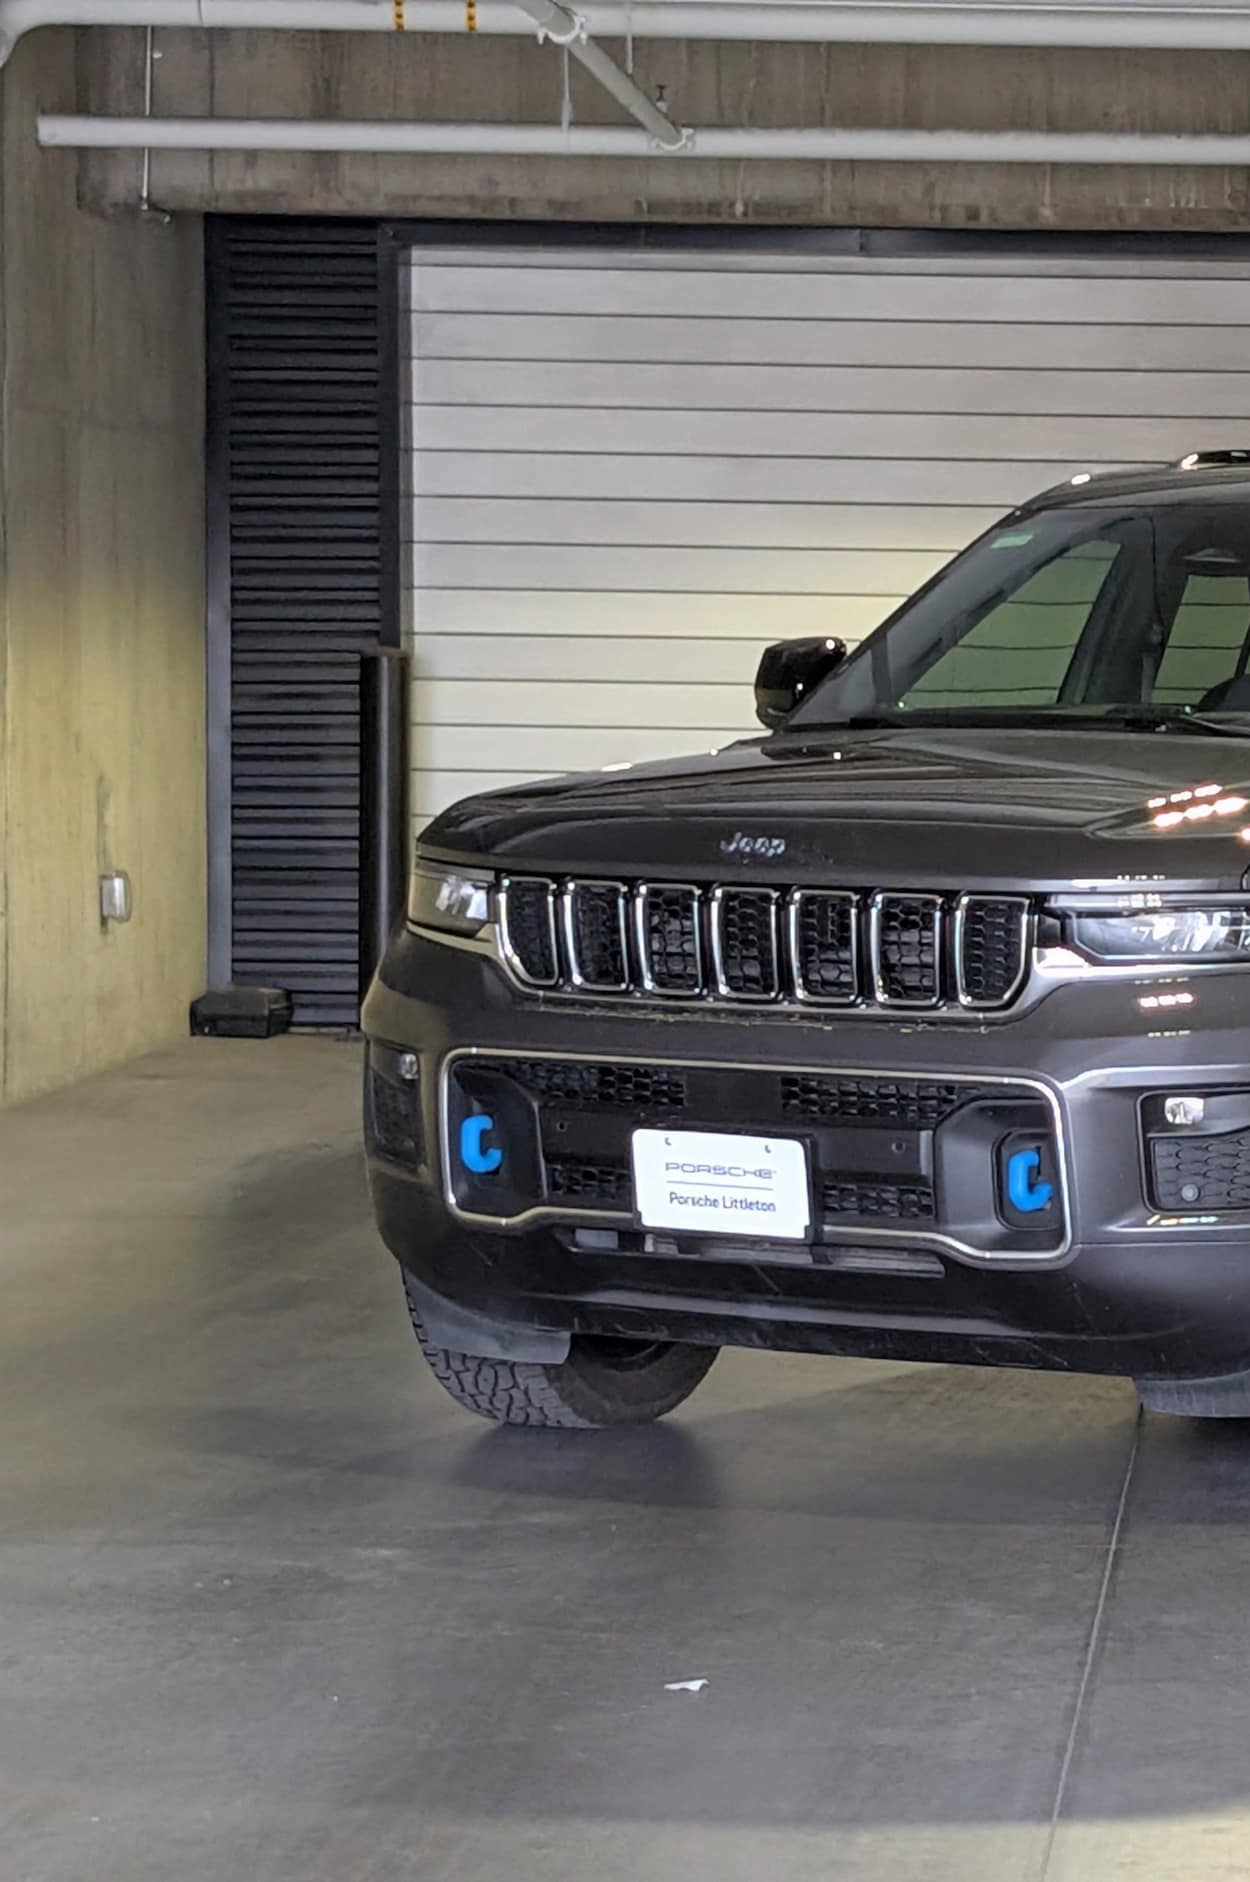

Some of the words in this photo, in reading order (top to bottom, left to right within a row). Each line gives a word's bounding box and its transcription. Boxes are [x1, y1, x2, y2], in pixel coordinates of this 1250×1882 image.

[720, 831, 785, 857] Jeep
[665, 1162, 774, 1180] PORSCHE
[669, 1191, 720, 1209] Porsche
[722, 1195, 776, 1212] Littleton
